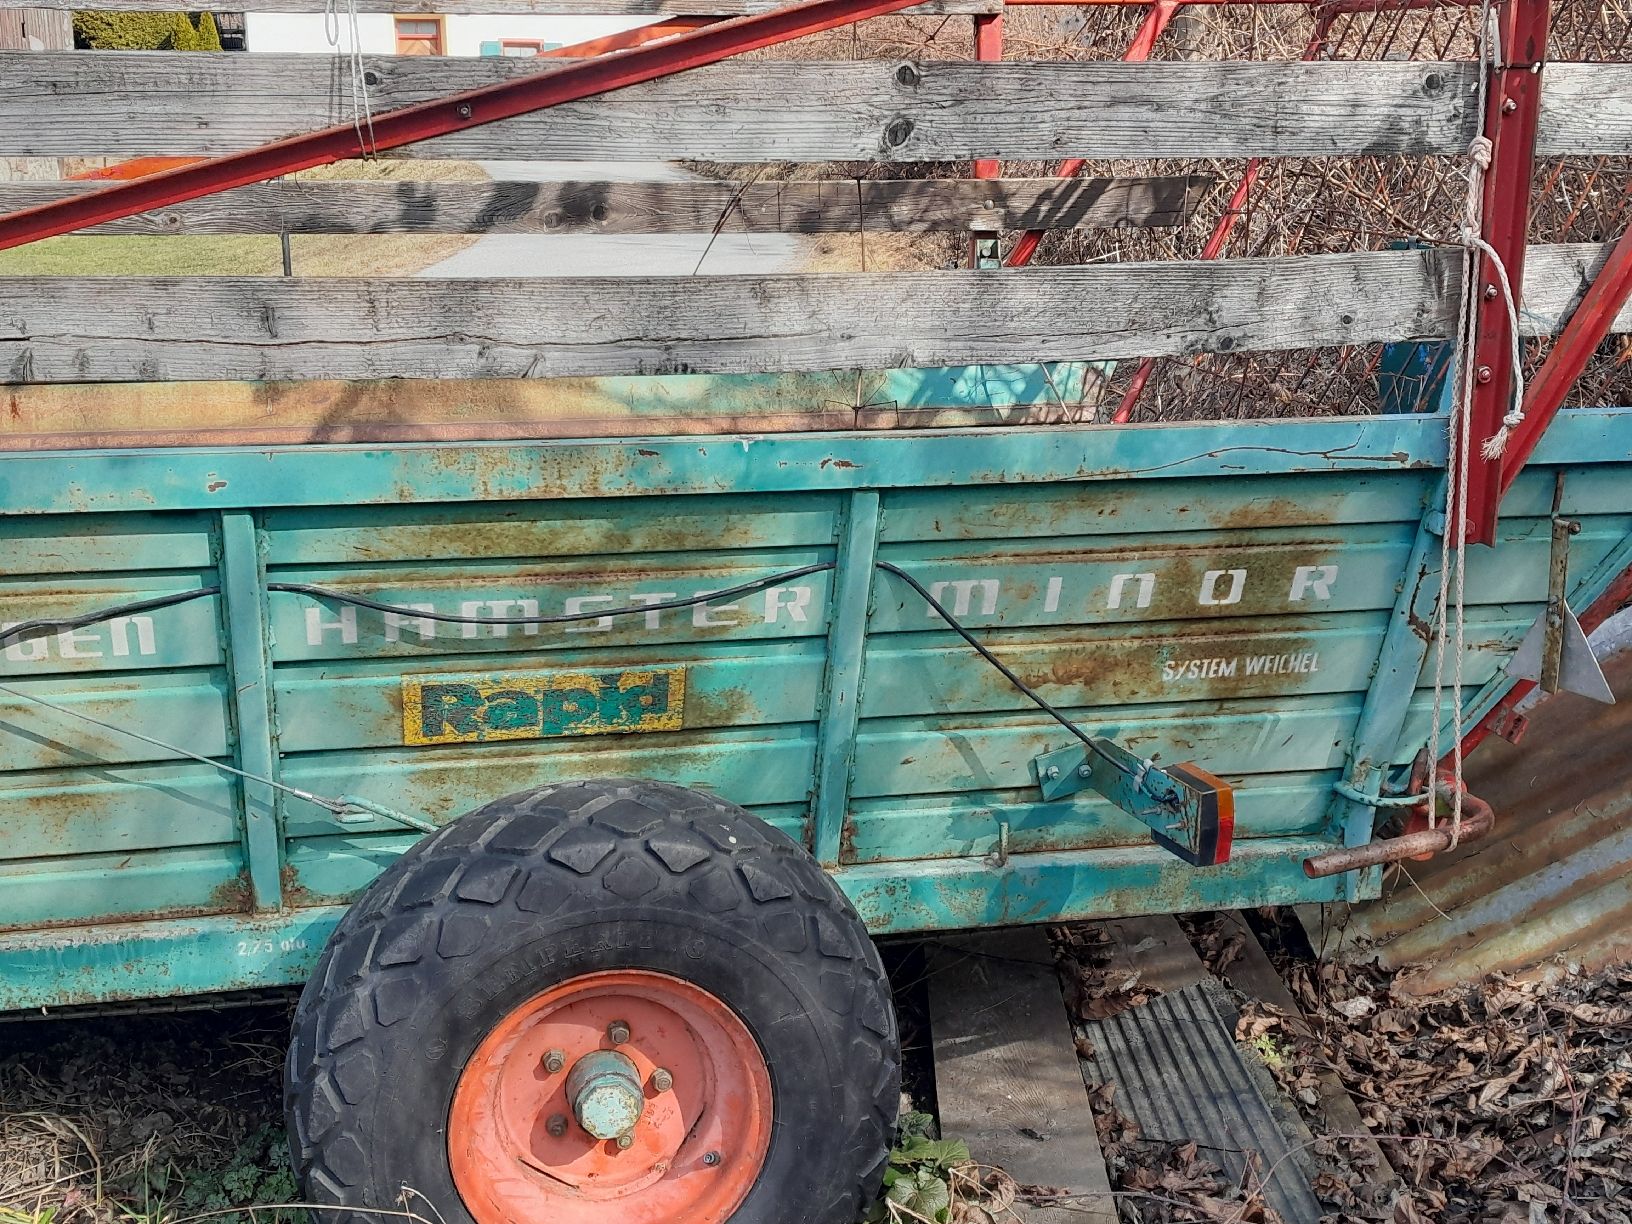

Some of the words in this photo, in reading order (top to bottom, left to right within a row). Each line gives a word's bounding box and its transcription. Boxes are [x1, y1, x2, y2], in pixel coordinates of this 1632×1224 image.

[304, 586, 811, 646] HAMSTER
[926, 564, 1340, 618] MINOR
[1161, 656, 1239, 683] SYSTEM
[1244, 651, 1320, 677] WEICHEL
